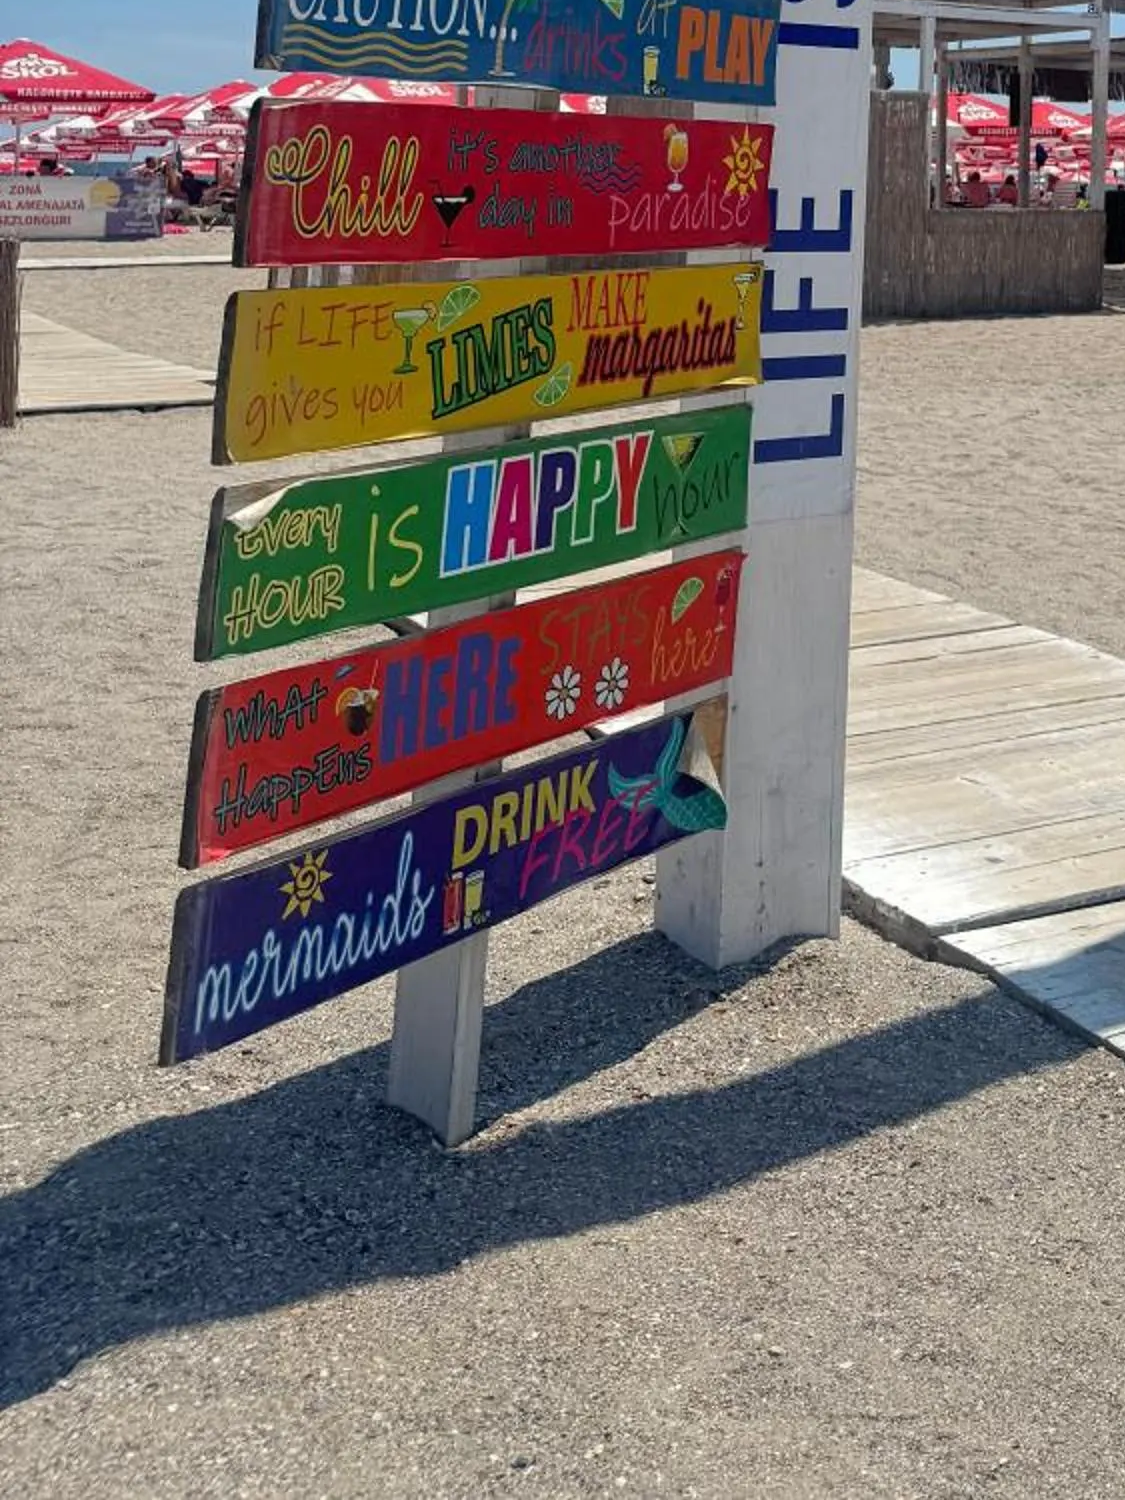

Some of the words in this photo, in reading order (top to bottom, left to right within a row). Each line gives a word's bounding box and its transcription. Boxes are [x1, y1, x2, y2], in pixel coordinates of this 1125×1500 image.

[0, 64, 78, 80] SKOL
[676, 5, 775, 86] PLAY
[264, 124, 424, 239] Chill
[477, 180, 539, 238] day
[546, 183, 574, 229] in
[608, 171, 752, 250] paradise
[255, 302, 286, 358] if
[297, 300, 395, 349] LIFE
[426, 296, 557, 420] LIMES
[566, 271, 651, 333] MAKE
[754, 188, 853, 465] LIFE
[245, 380, 340, 447] gives
[352, 380, 405, 427] you
[438, 429, 655, 579] HAPPY
[223, 563, 346, 646] HOUR
[378, 632, 522, 764] HERE
[451, 758, 600, 871] DRINK
[519, 779, 662, 900] FREE
[195, 830, 435, 1035] mermaids
